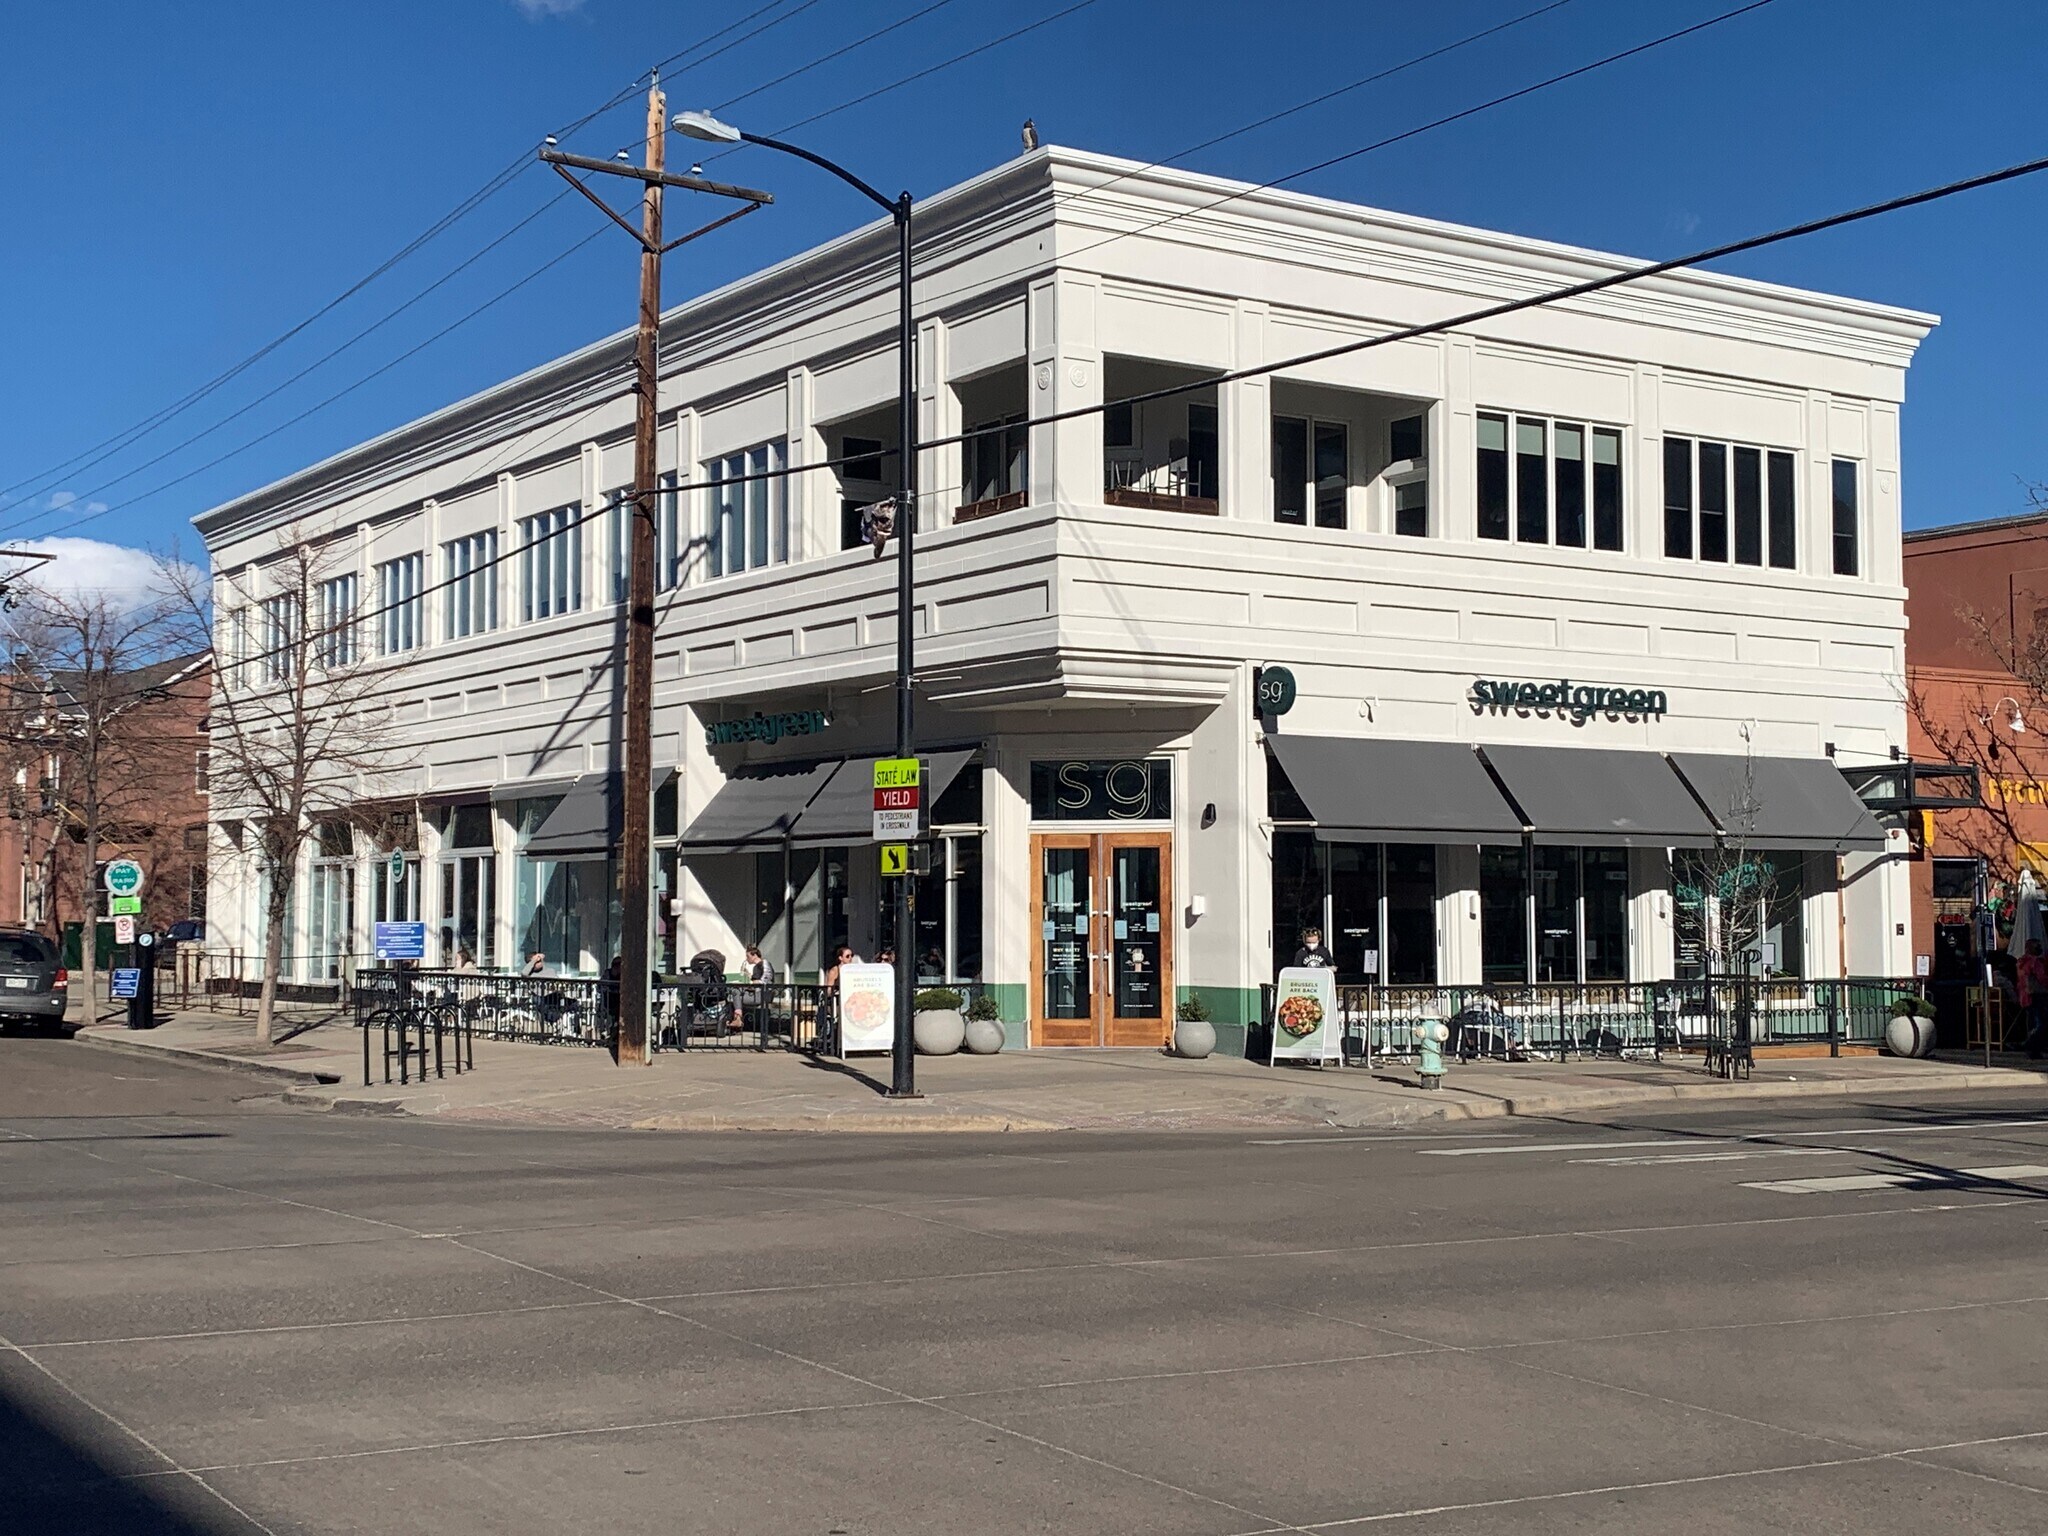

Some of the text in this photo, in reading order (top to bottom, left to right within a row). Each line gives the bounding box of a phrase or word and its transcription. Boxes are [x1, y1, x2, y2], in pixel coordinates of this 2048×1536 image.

[1260, 681, 1283, 703] sg
[1473, 678, 1667, 716] sweetgreen
[704, 709, 826, 745] sweetgreen
[876, 769, 917, 785] STATE LAW
[882, 790, 911, 806] YIELD
[879, 812, 913, 821] TO PEDESTRIANS
[886, 822, 911, 830] CROSSWALK
